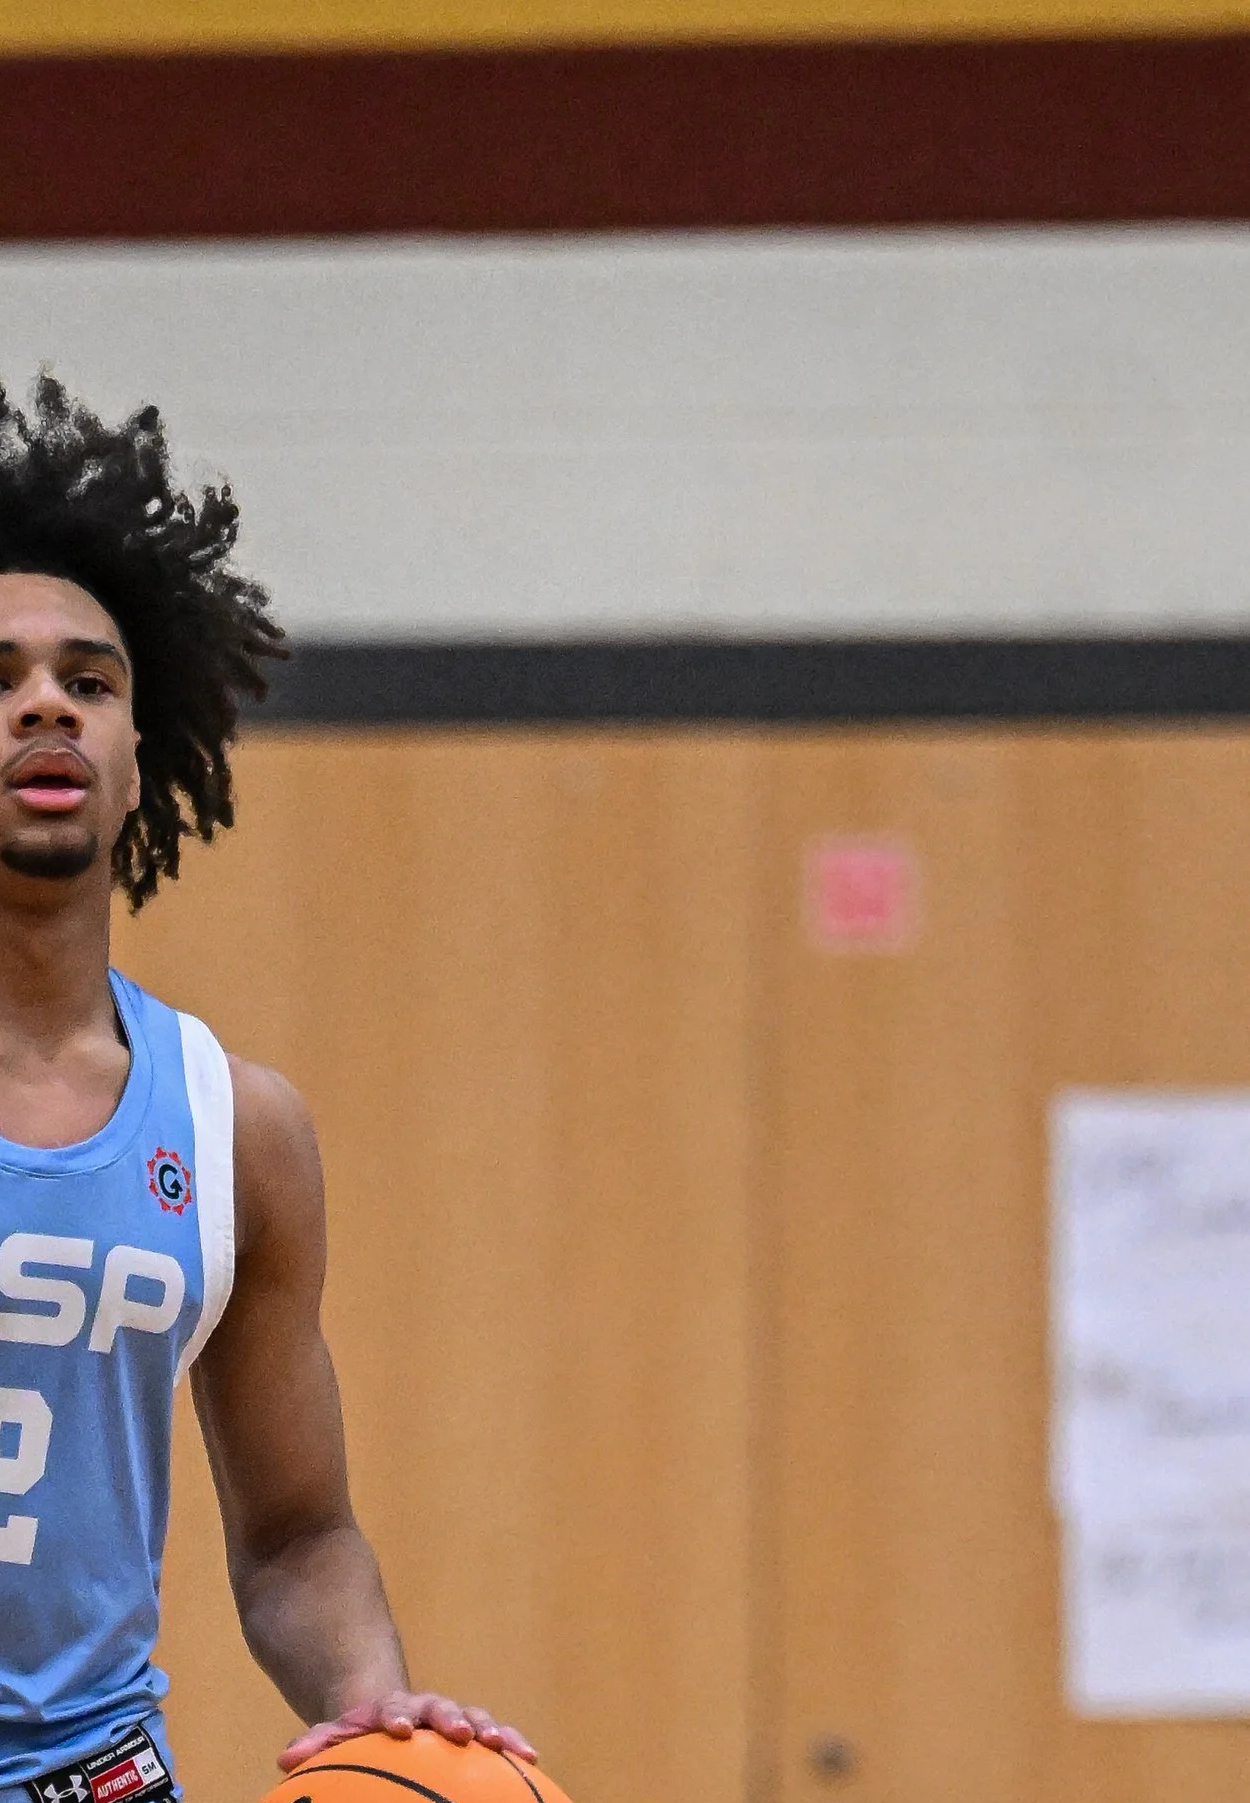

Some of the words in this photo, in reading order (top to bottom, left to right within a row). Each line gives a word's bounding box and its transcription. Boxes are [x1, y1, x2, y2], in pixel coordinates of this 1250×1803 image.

[86, 1752, 116, 1770] UNDER
[116, 1736, 145, 1756] ARMOUR
[97, 1770, 139, 1799] AUTHENTIC
